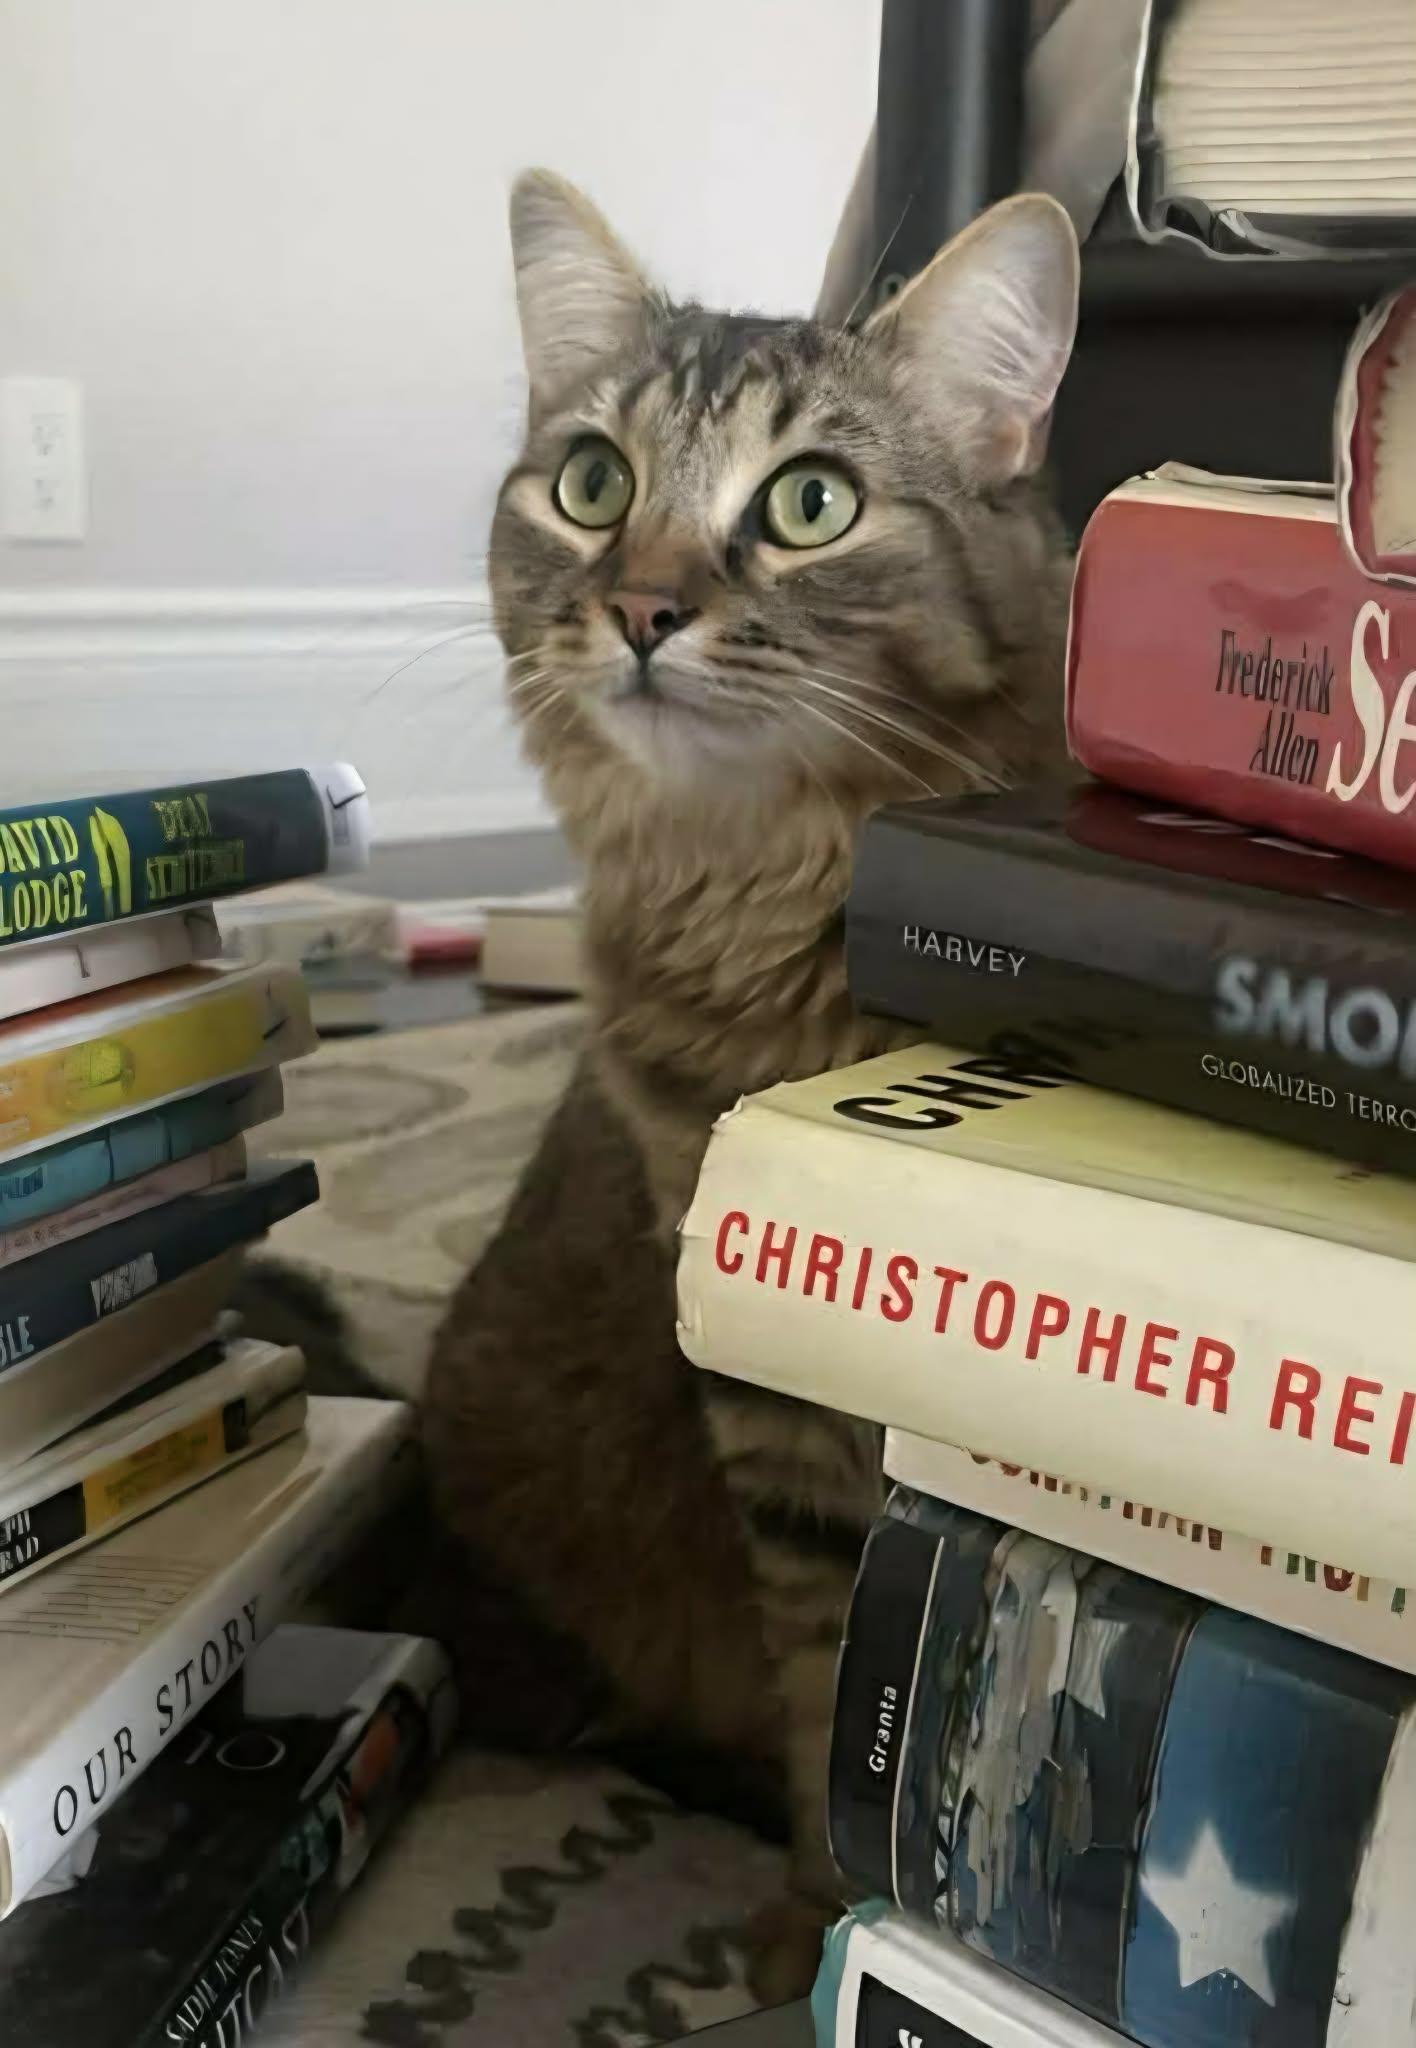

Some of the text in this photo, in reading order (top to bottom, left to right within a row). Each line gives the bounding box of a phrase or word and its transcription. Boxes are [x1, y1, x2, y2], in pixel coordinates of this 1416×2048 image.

[1216, 629, 1334, 714] Frederick
[1249, 710, 1319, 784] Allen
[904, 925, 1026, 976] HARVEY
[1202, 1054, 1416, 1132] GLOBALIZED TERRO
[715, 1210, 1416, 1465] CHRISTOPHER REI
[53, 1726, 137, 1837] OUR
[156, 1595, 257, 1737] STORY
[869, 1685, 897, 1773] Granta
